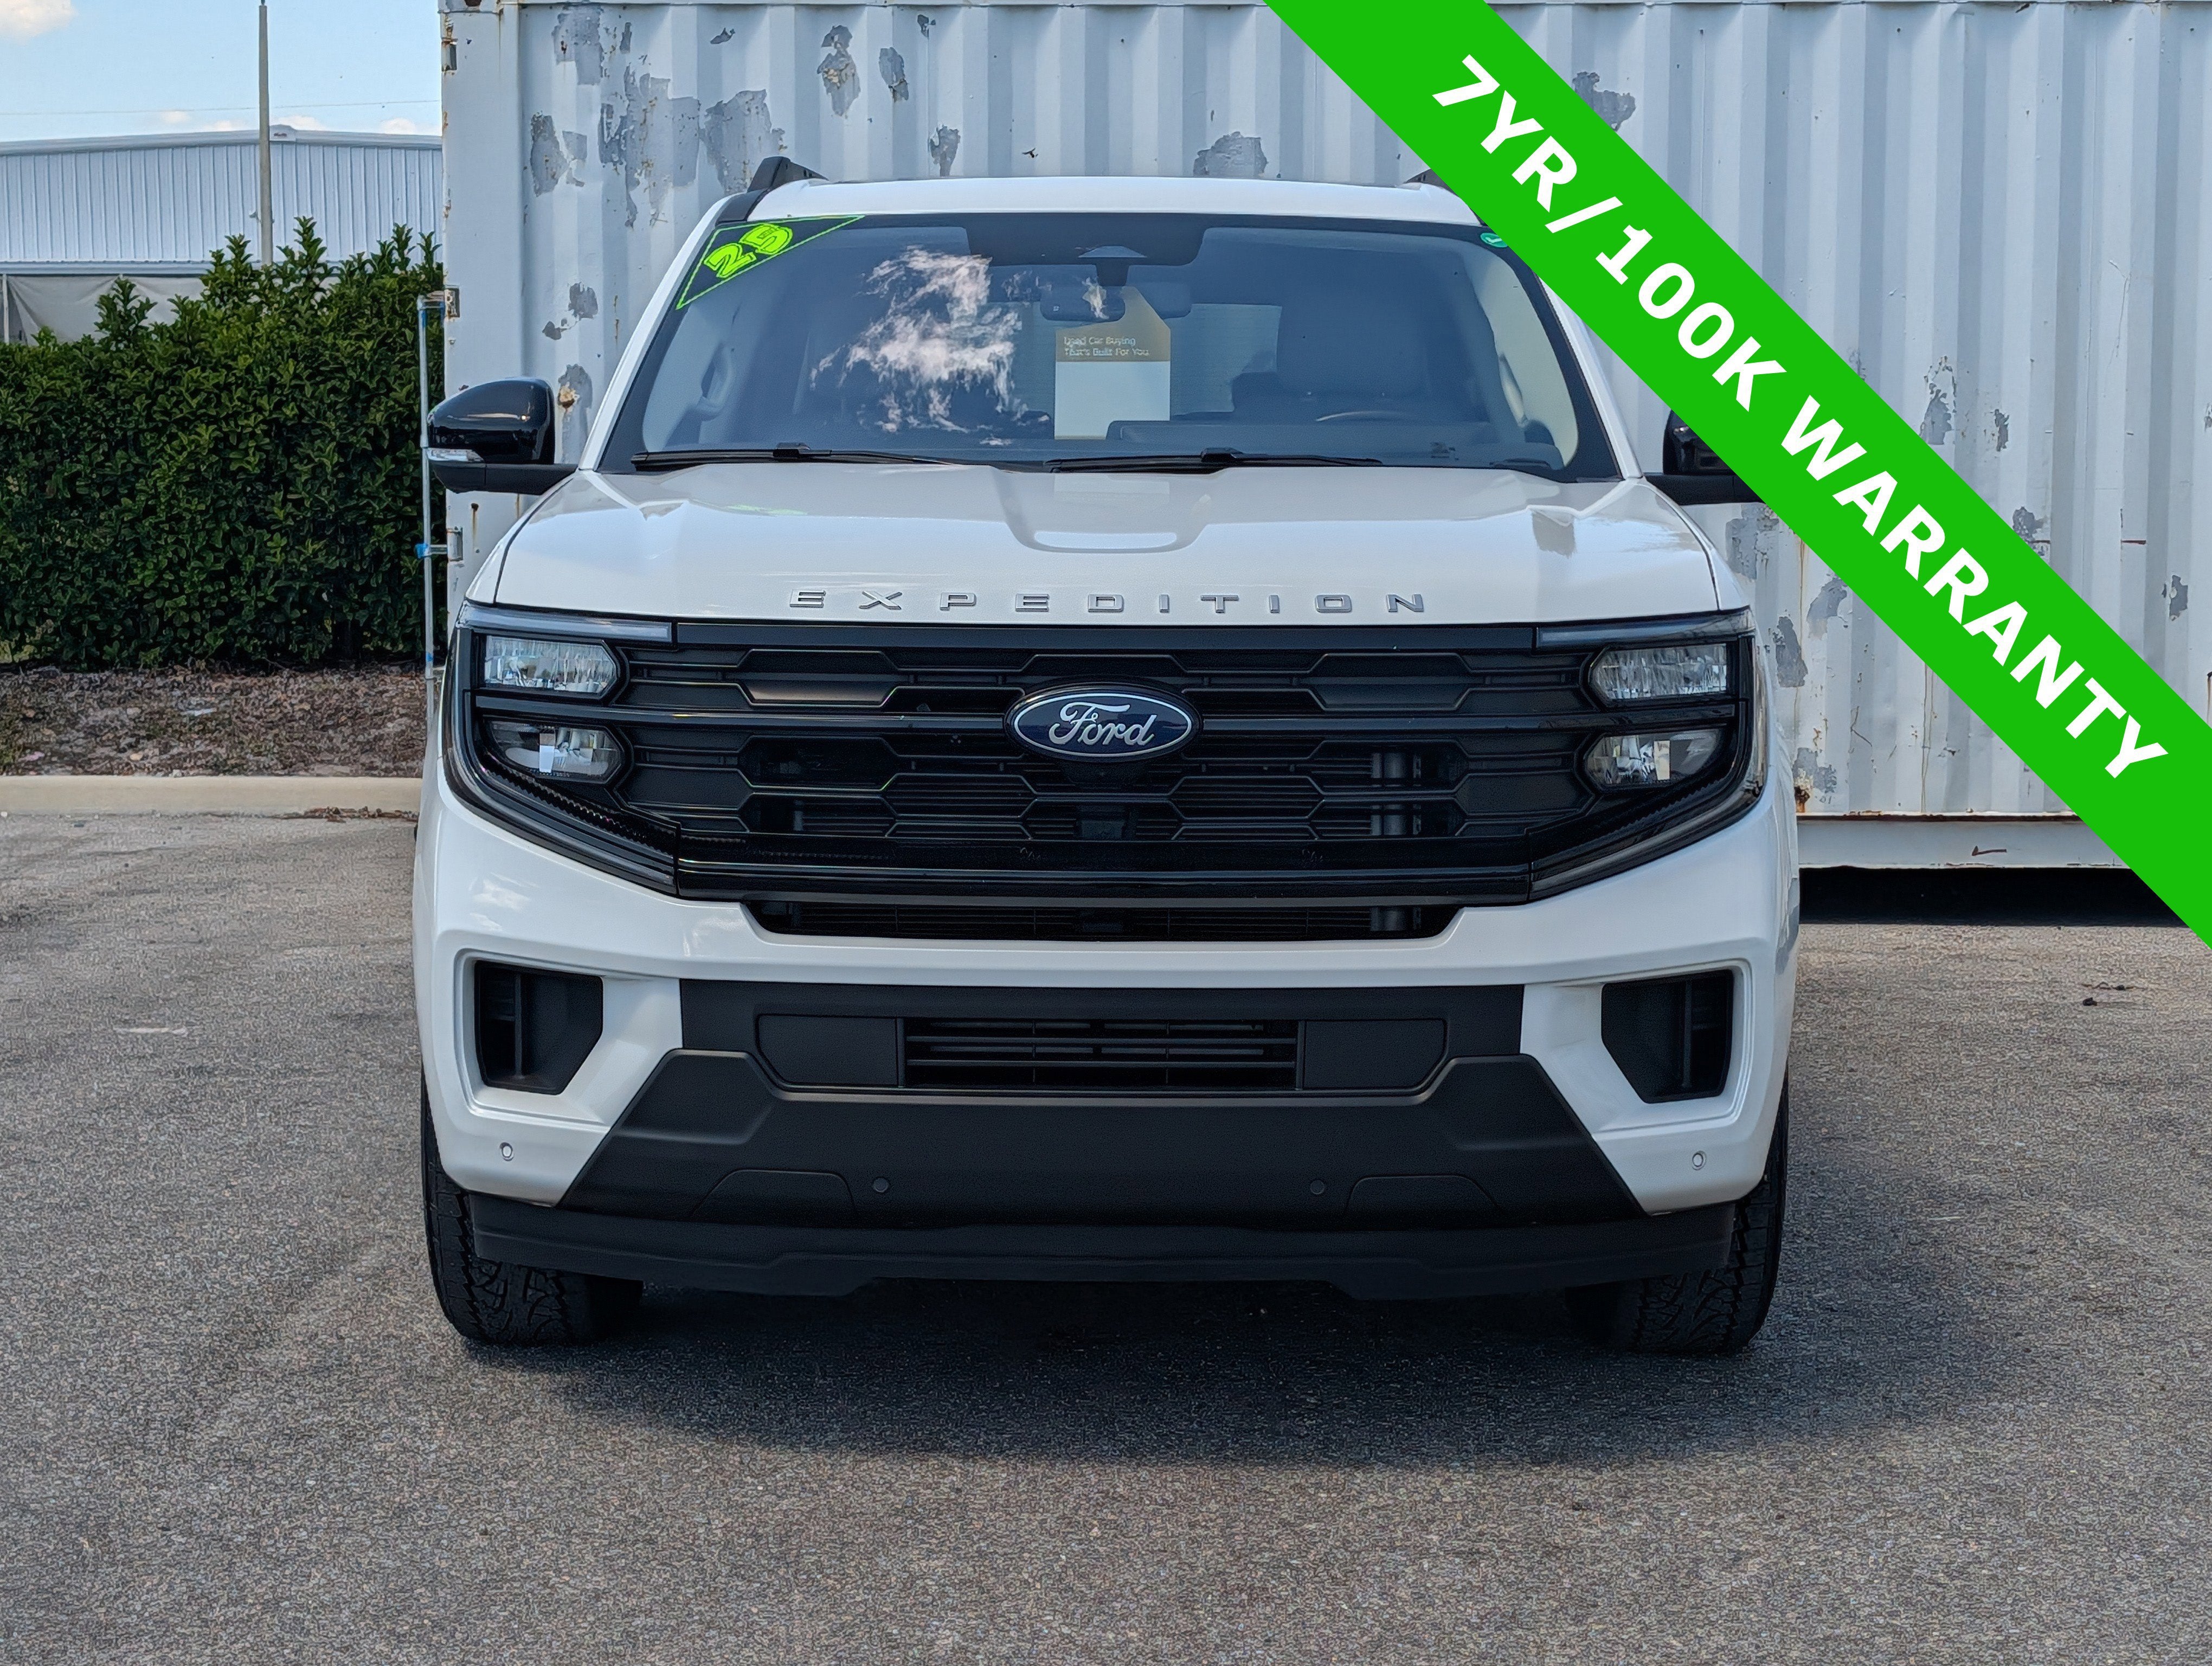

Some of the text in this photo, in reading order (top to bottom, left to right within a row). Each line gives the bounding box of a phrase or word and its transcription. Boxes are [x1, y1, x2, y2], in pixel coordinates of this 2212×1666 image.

[704, 222, 793, 278] 25
[789, 588, 1424, 614] EXPEDITION
[1049, 701, 1158, 746] Ford
